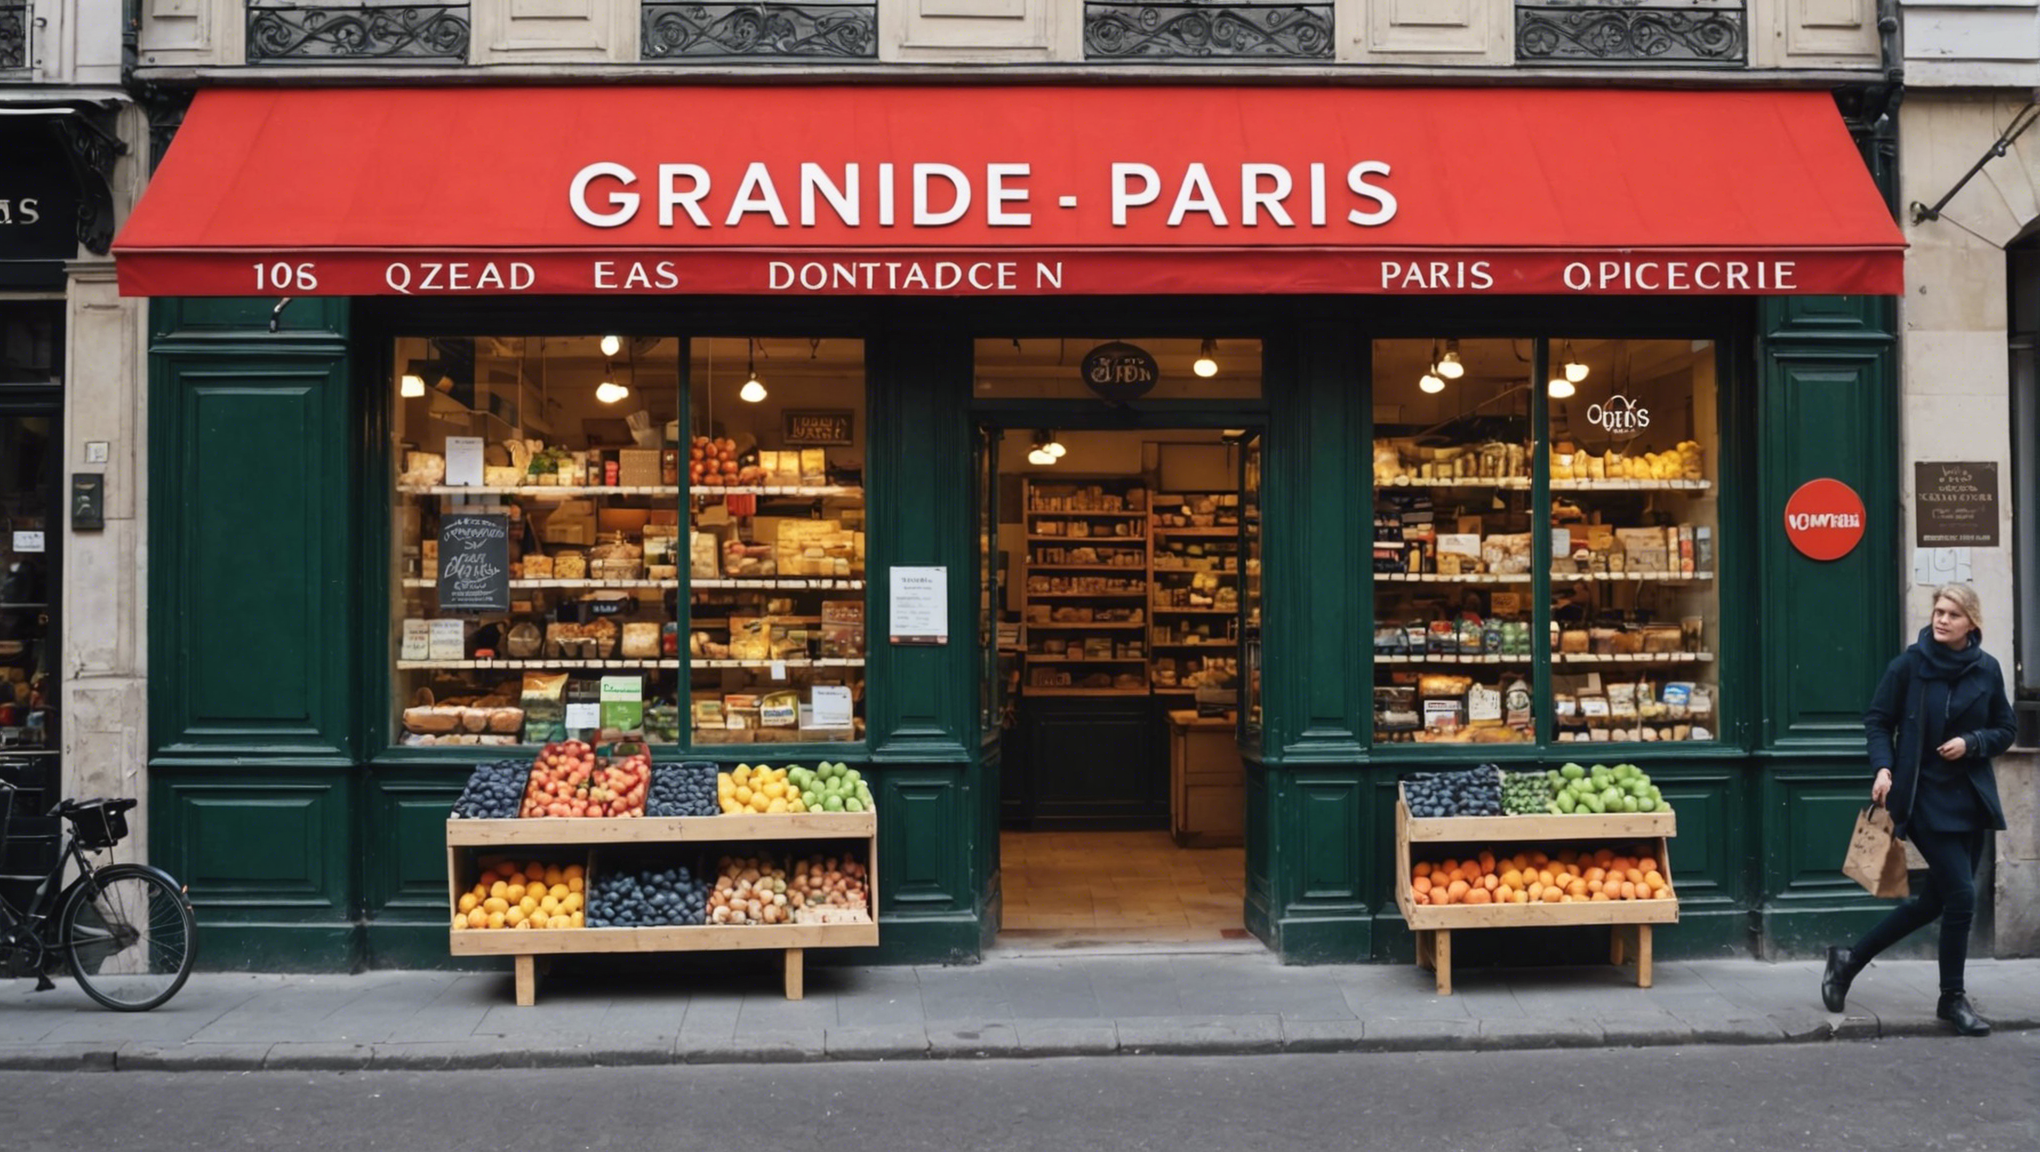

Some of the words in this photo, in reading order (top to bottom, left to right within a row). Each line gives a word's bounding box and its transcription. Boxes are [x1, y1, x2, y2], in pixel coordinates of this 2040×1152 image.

[569, 161, 1033, 228] GRANIDE
[1111, 160, 1399, 228] PARIS
[385, 262, 535, 294] QZEAD
[594, 261, 679, 289] EAS
[768, 261, 1017, 290] DONTTADCE
[1381, 261, 1494, 290] PARIS
